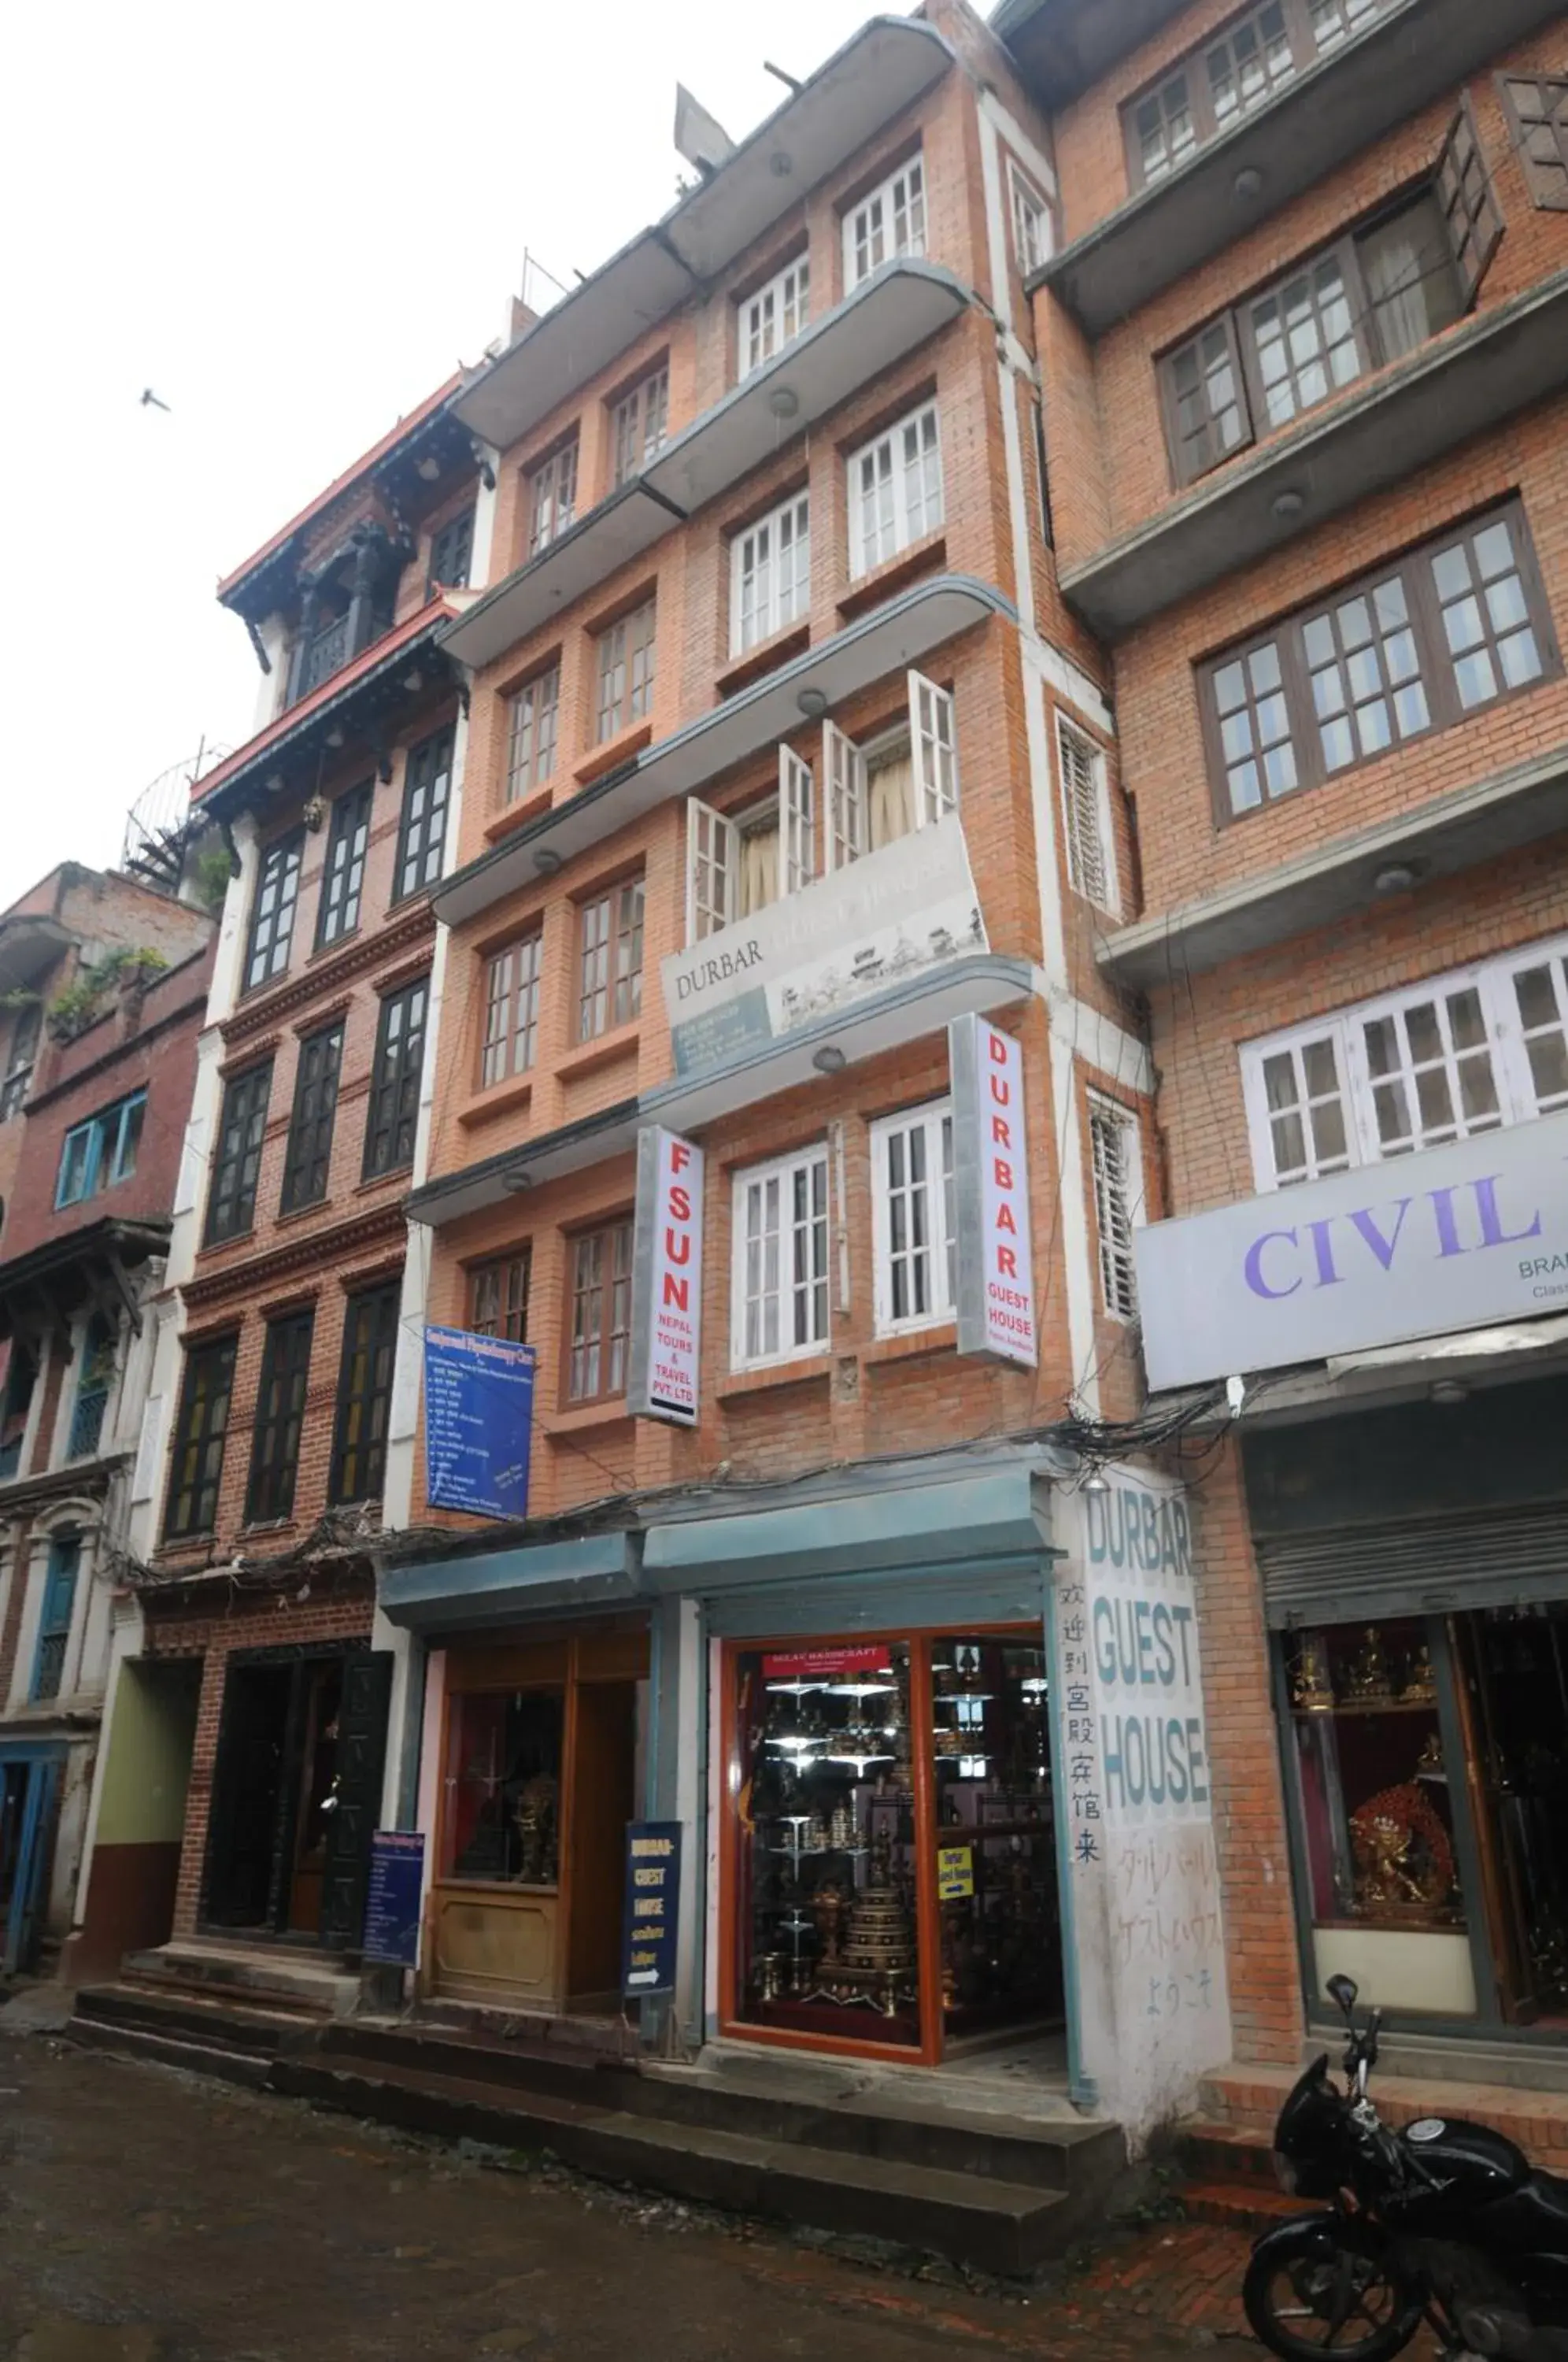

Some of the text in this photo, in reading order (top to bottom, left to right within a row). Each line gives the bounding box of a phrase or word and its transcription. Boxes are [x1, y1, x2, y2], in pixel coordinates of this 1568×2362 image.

[676, 939, 764, 1001] DURBAR
[989, 1033, 1017, 1279] DURBAR
[1244, 1173, 1541, 1299] CIVIL
[1518, 1252, 1568, 1279] BRA
[988, 1282, 1030, 1312] GUEST
[659, 1310, 693, 1335] NEPAL
[988, 1308, 1032, 1337] HOUSE
[657, 1332, 693, 1353] TOURS
[671, 1353, 679, 1364] &
[655, 1364, 691, 1385] TRAVEL
[1087, 1487, 1191, 1575] DURBAR
[1093, 1596, 1192, 1686] GUEST
[1100, 1715, 1208, 1808] HOUSE
